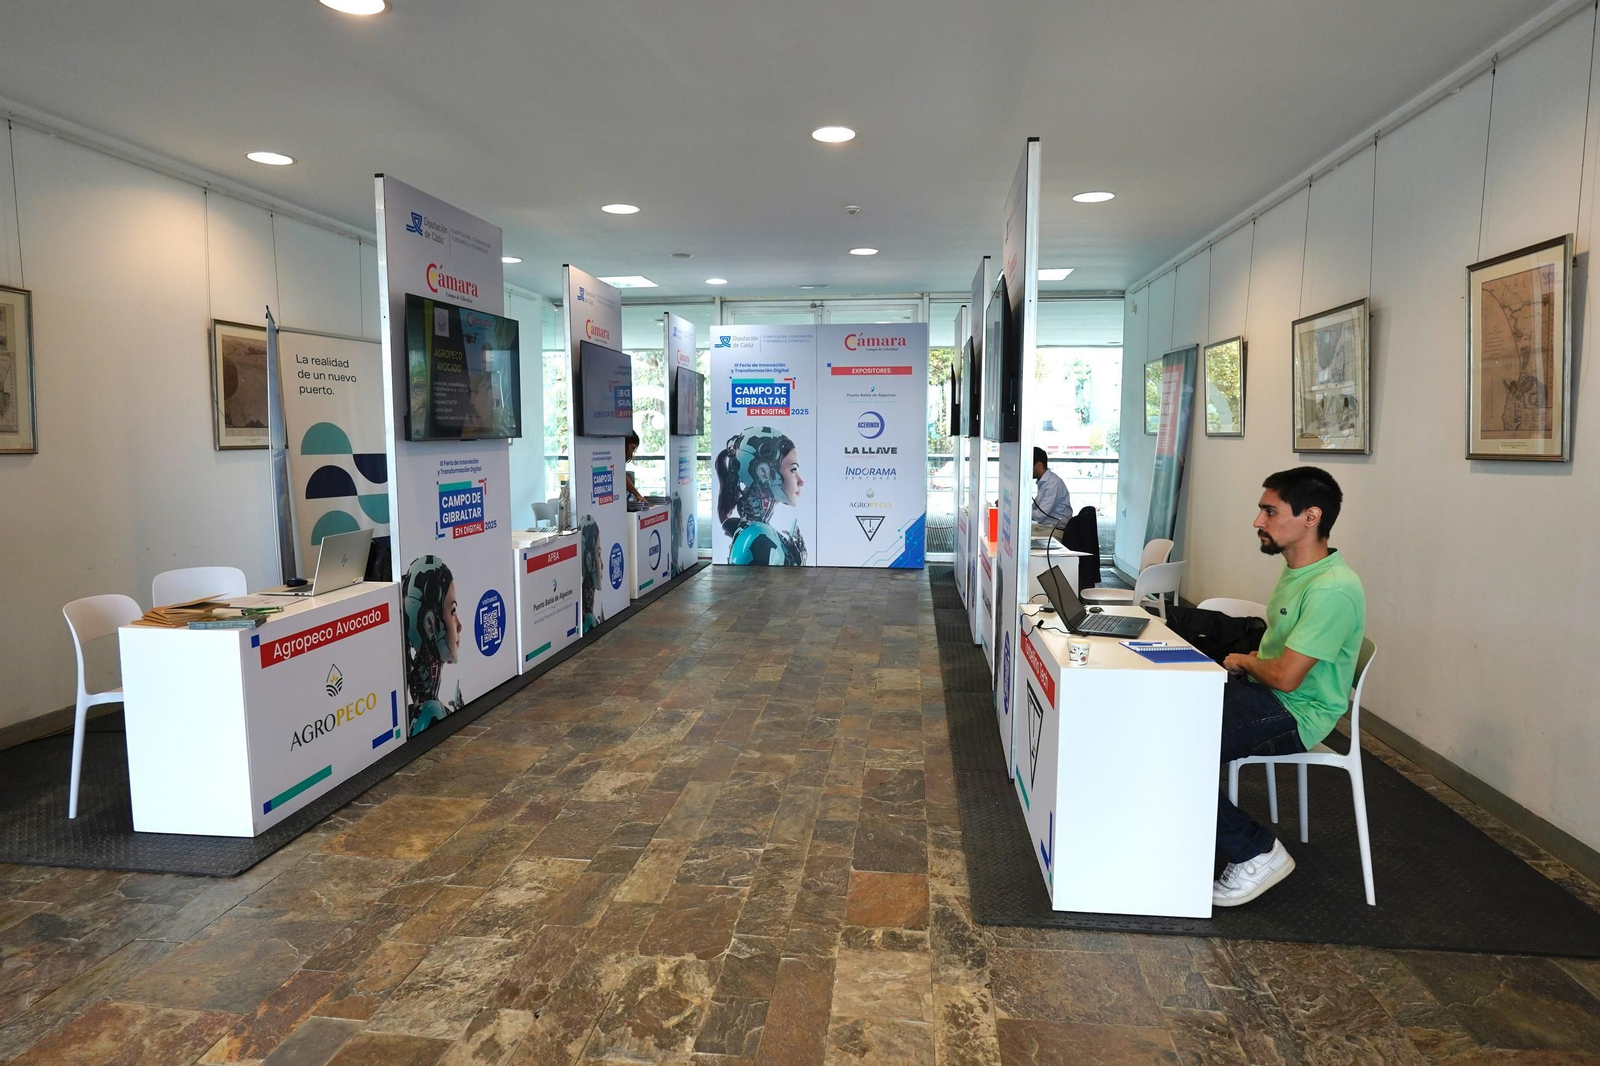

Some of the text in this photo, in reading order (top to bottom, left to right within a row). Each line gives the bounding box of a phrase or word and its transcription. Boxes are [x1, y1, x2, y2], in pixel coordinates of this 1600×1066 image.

[424, 217, 448, 234] Diputación
[424, 230, 444, 245] de Cádiz
[426, 263, 479, 298] Cámara
[844, 333, 906, 351] Cámara
[295, 354, 350, 368] La realidad
[434, 348, 463, 360] AGROPECO
[436, 362, 462, 373] AVOCADO
[297, 369, 357, 382] de un nuevo
[299, 385, 334, 395] puerto.
[735, 386, 787, 395] CAMPO DE
[735, 397, 787, 405] GIBRALTAR
[440, 467, 470, 475] Transformación
[470, 466, 482, 474] Digital
[845, 466, 896, 476] INDORAMA
[442, 492, 482, 508] CAMPO DE
[442, 507, 482, 524] GIBRALTAR
[455, 520, 497, 536] EN DIGITAL 2025
[547, 551, 559, 564] APBA
[273, 608, 382, 660] Agropeco Avocado
[290, 692, 378, 752] AGROPECO
